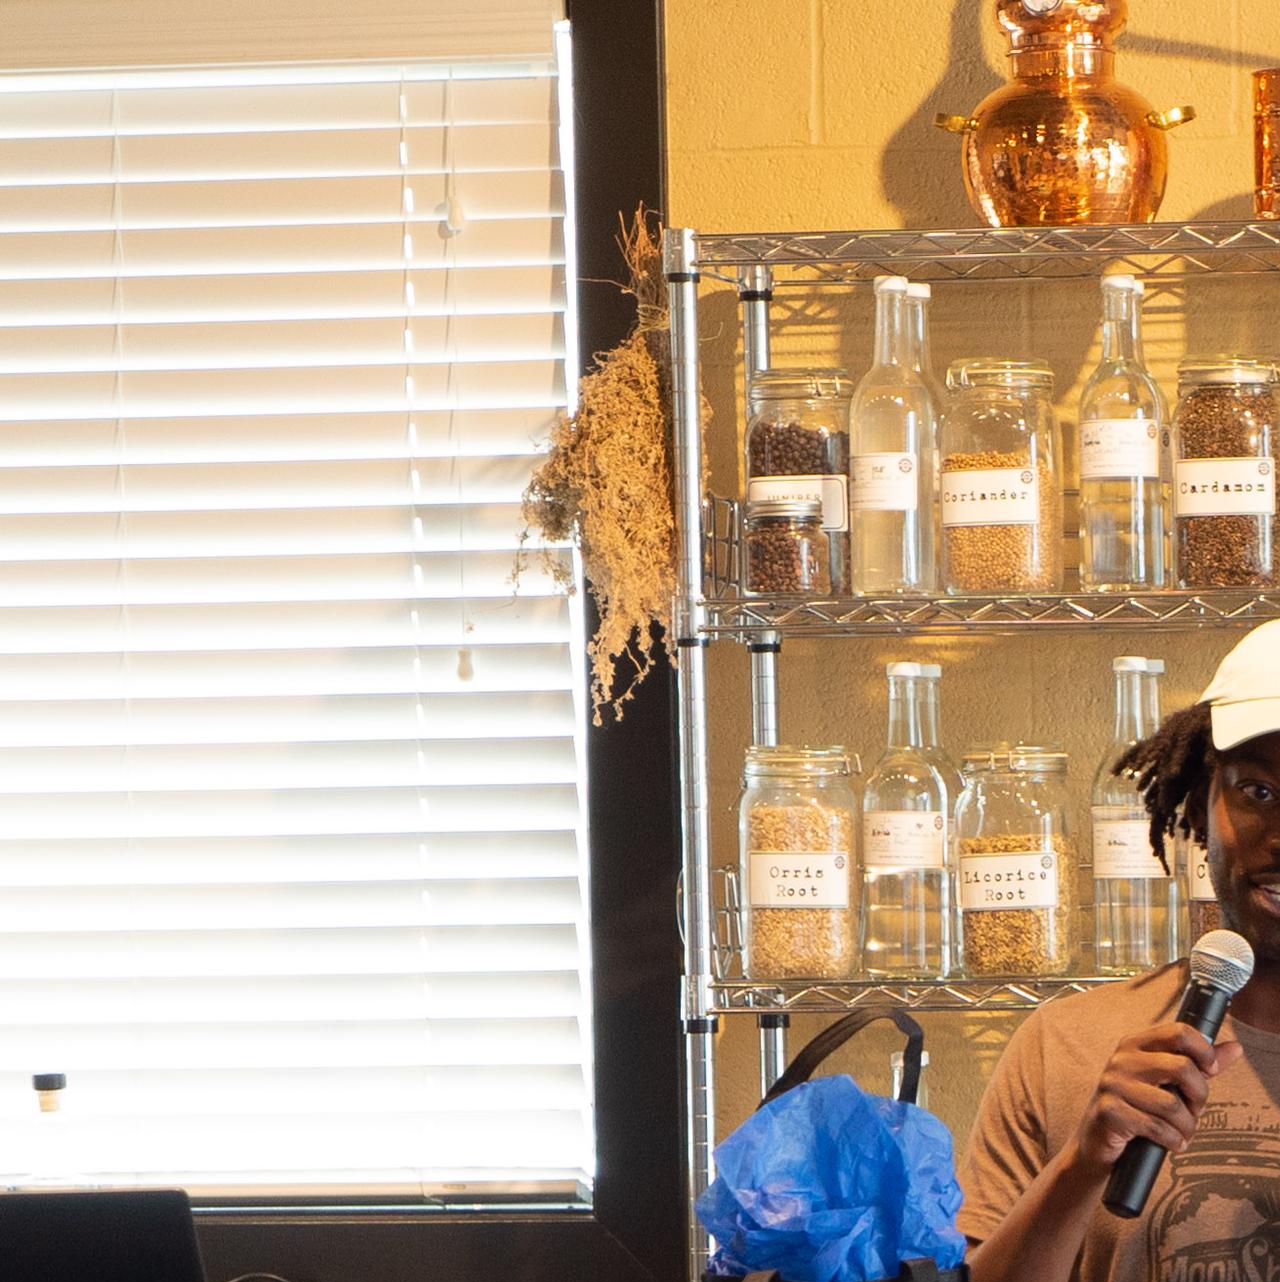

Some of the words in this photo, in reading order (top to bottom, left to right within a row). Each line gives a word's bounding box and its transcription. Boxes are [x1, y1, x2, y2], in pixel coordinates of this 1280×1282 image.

[943, 489, 1029, 503] Coriander
[769, 866, 824, 879] Orris
[965, 869, 1046, 884] Licorice
[776, 884, 818, 897] Root
[985, 888, 1025, 901] Root
